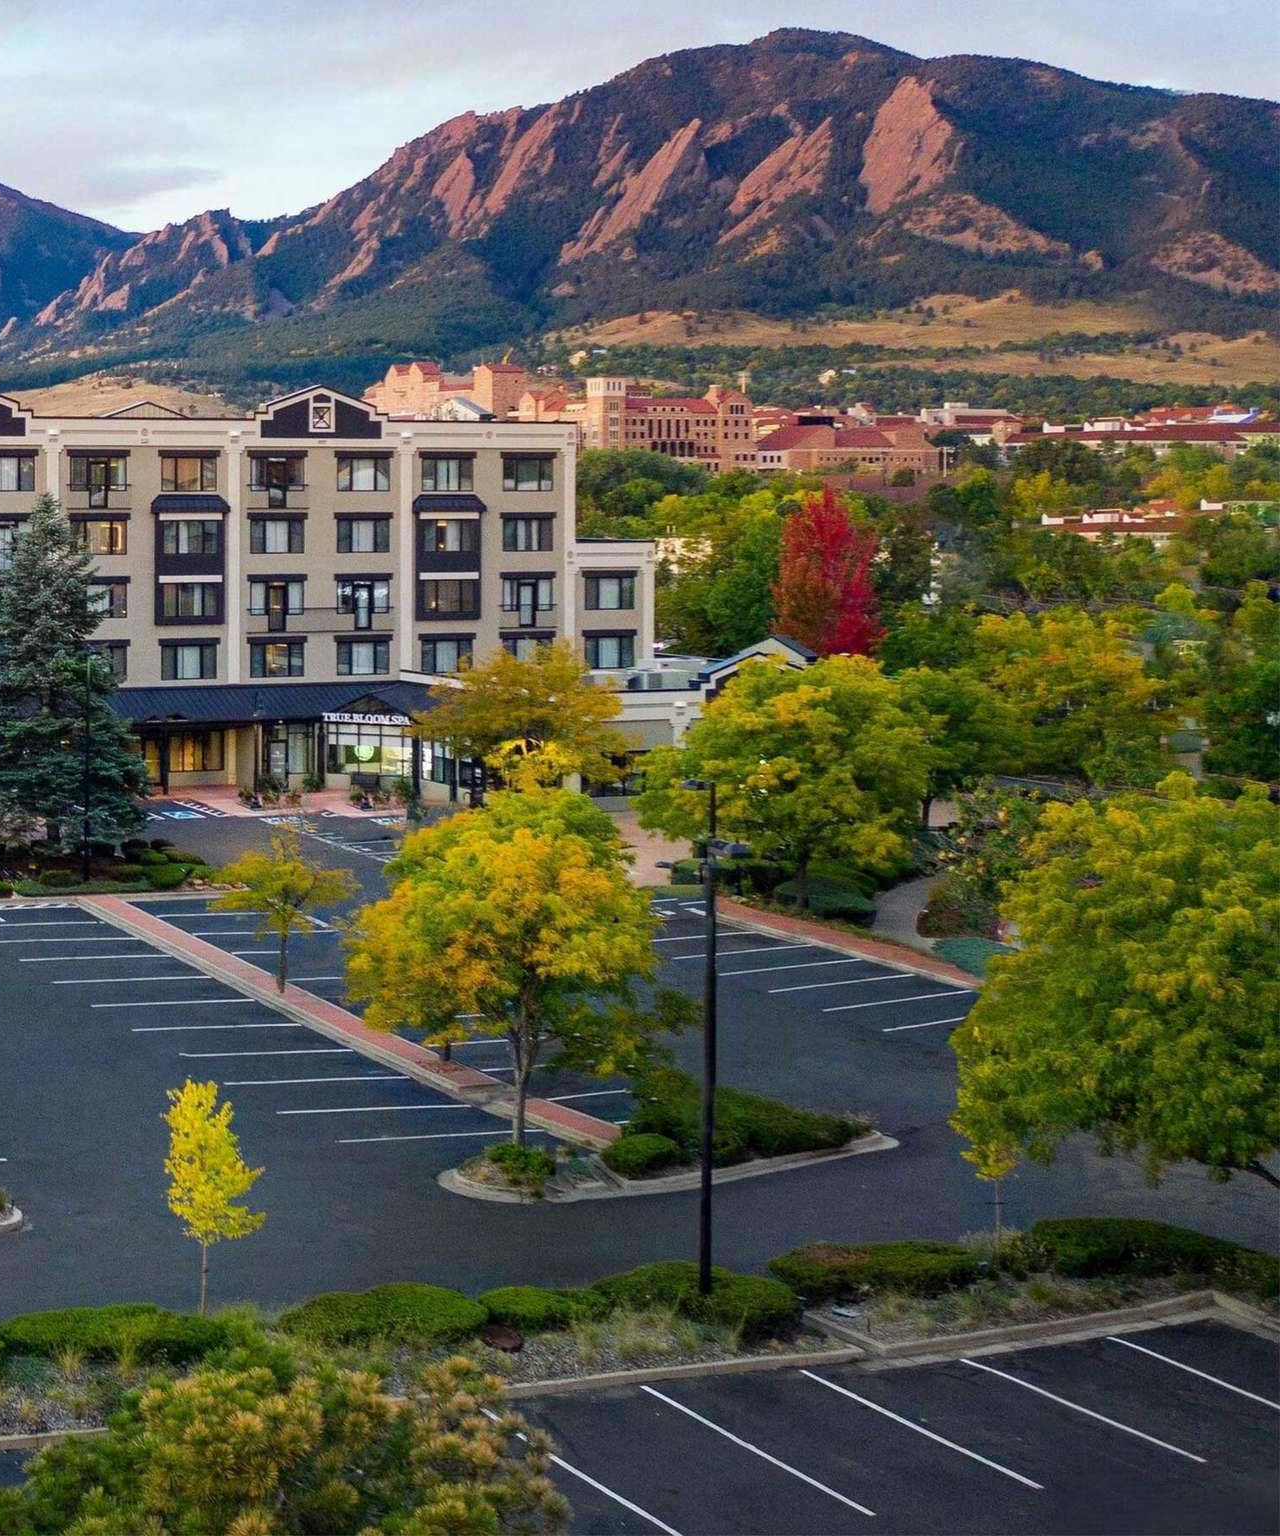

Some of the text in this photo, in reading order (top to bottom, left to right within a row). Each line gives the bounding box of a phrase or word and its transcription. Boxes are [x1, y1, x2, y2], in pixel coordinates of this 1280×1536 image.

[322, 712, 412, 726] TRUE BLOOM SPA
